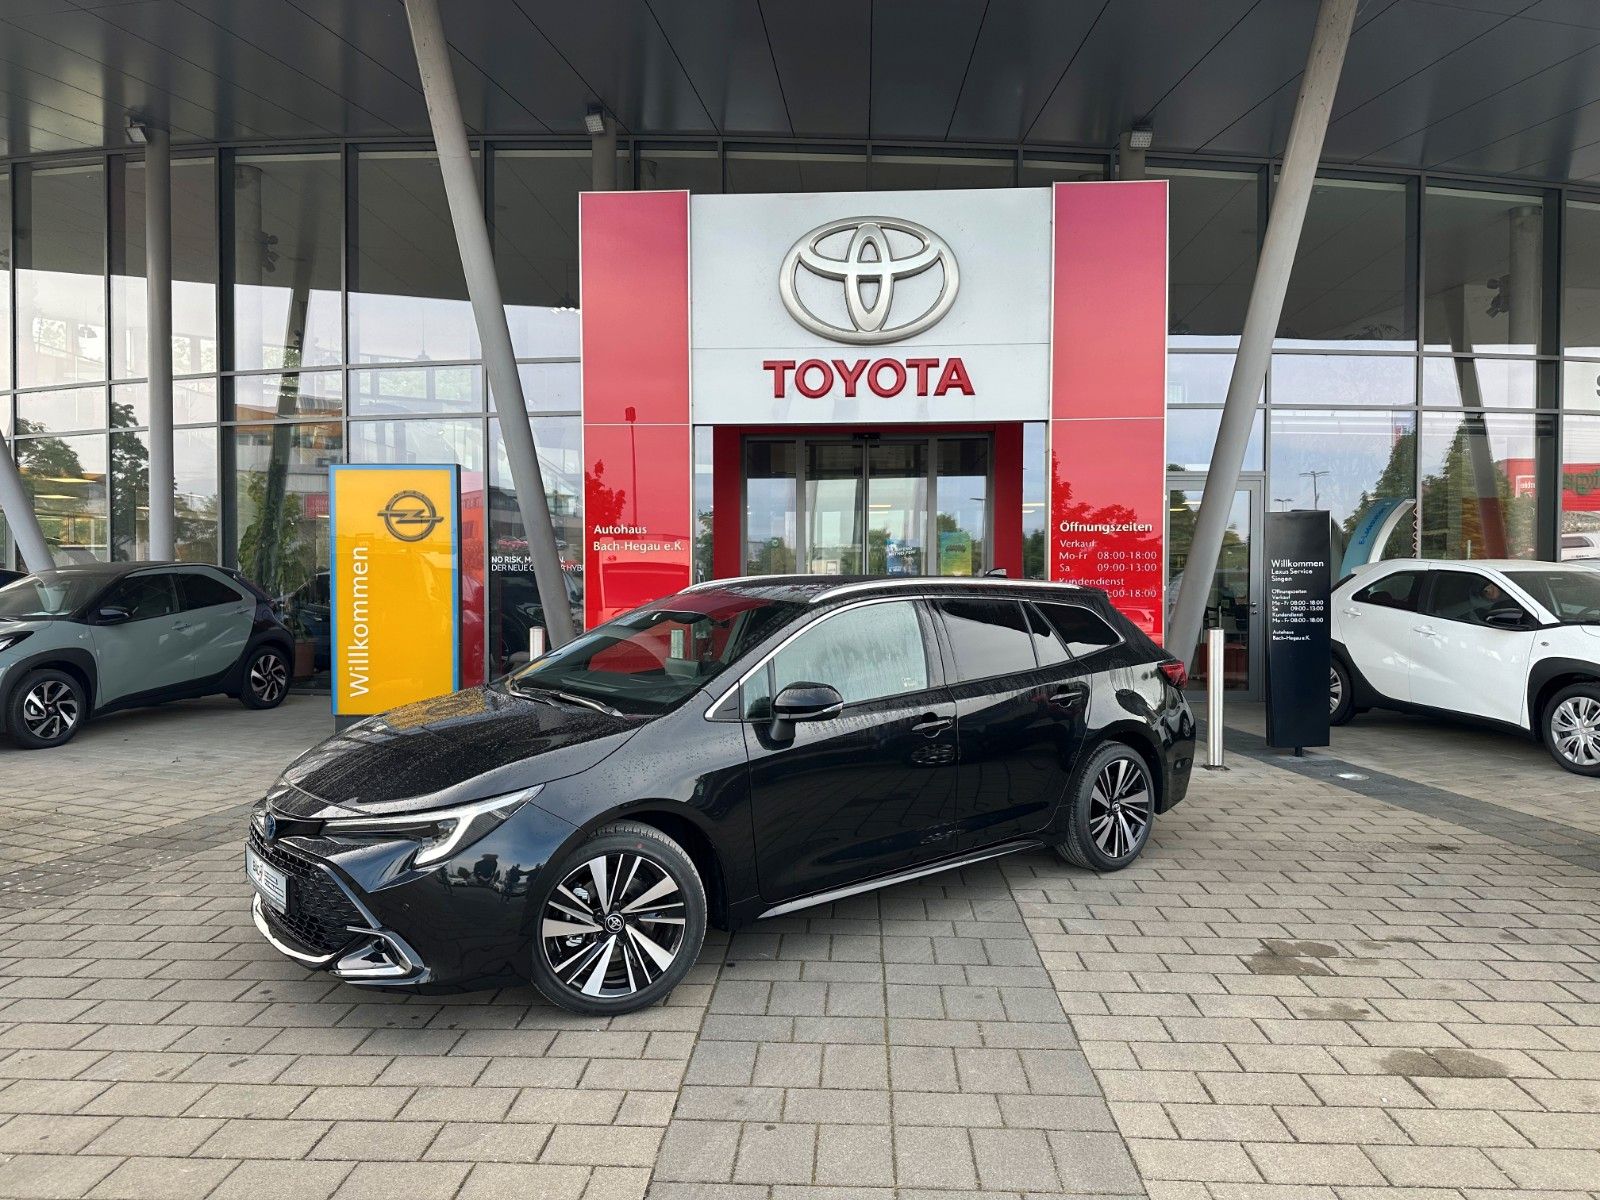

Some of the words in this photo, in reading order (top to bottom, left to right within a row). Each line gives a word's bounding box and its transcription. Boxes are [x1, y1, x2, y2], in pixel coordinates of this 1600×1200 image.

[763, 358, 975, 398] TOYOTA
[594, 524, 647, 534] Autohaus
[1060, 520, 1152, 534] Öffnungszeiten
[594, 541, 660, 553] Bach-Hegau
[664, 542, 684, 551] e.K.
[1097, 552, 1156, 560] 08:00-18:00
[1097, 564, 1156, 572] 09:00-13:00
[1271, 559, 1324, 568] Willkommen
[348, 547, 369, 697] Willkommen
